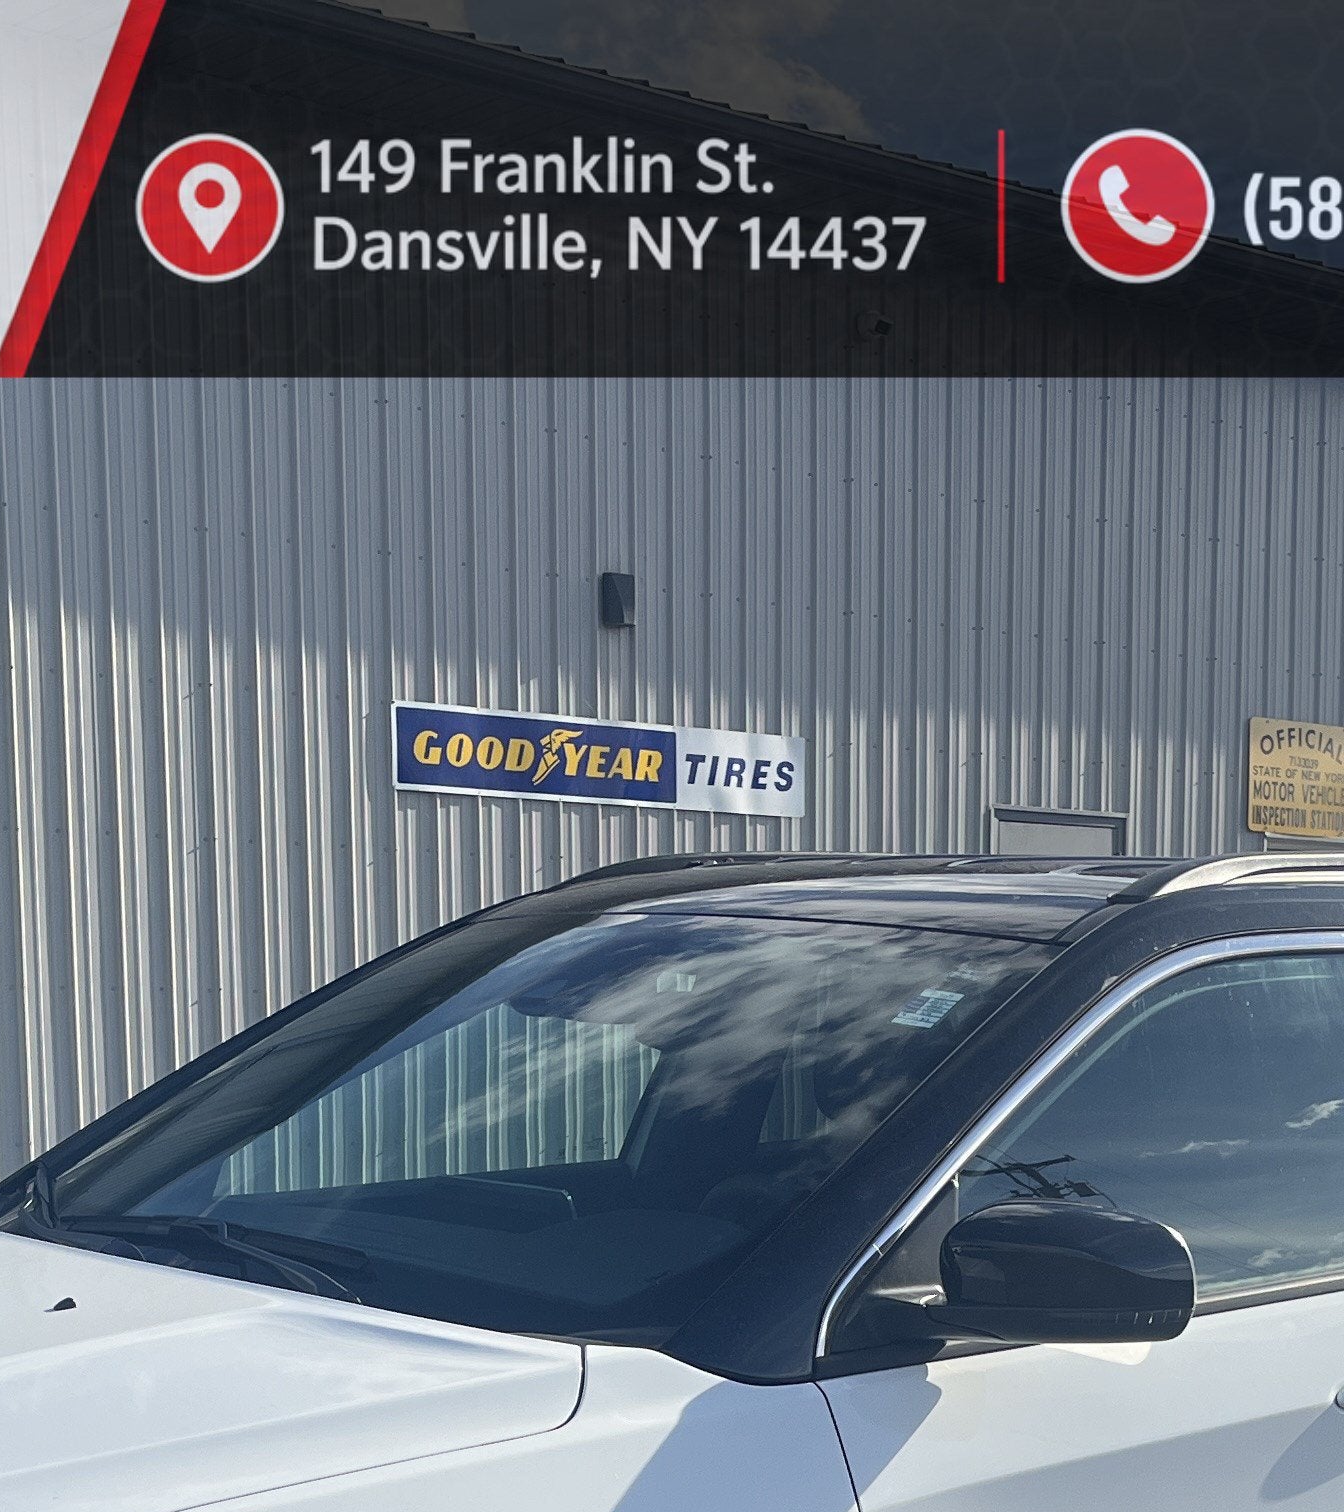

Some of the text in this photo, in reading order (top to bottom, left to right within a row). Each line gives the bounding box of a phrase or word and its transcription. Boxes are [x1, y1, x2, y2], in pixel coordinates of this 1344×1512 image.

[1260, 728, 1343, 765] OFFICIAL
[685, 753, 795, 792] TIRES
[1252, 765, 1281, 778] STATE
[1285, 768, 1298, 779] OF
[1302, 770, 1321, 781] NEW
[1253, 780, 1295, 802] MOTOR
[1252, 804, 1306, 828] INSPECTION
